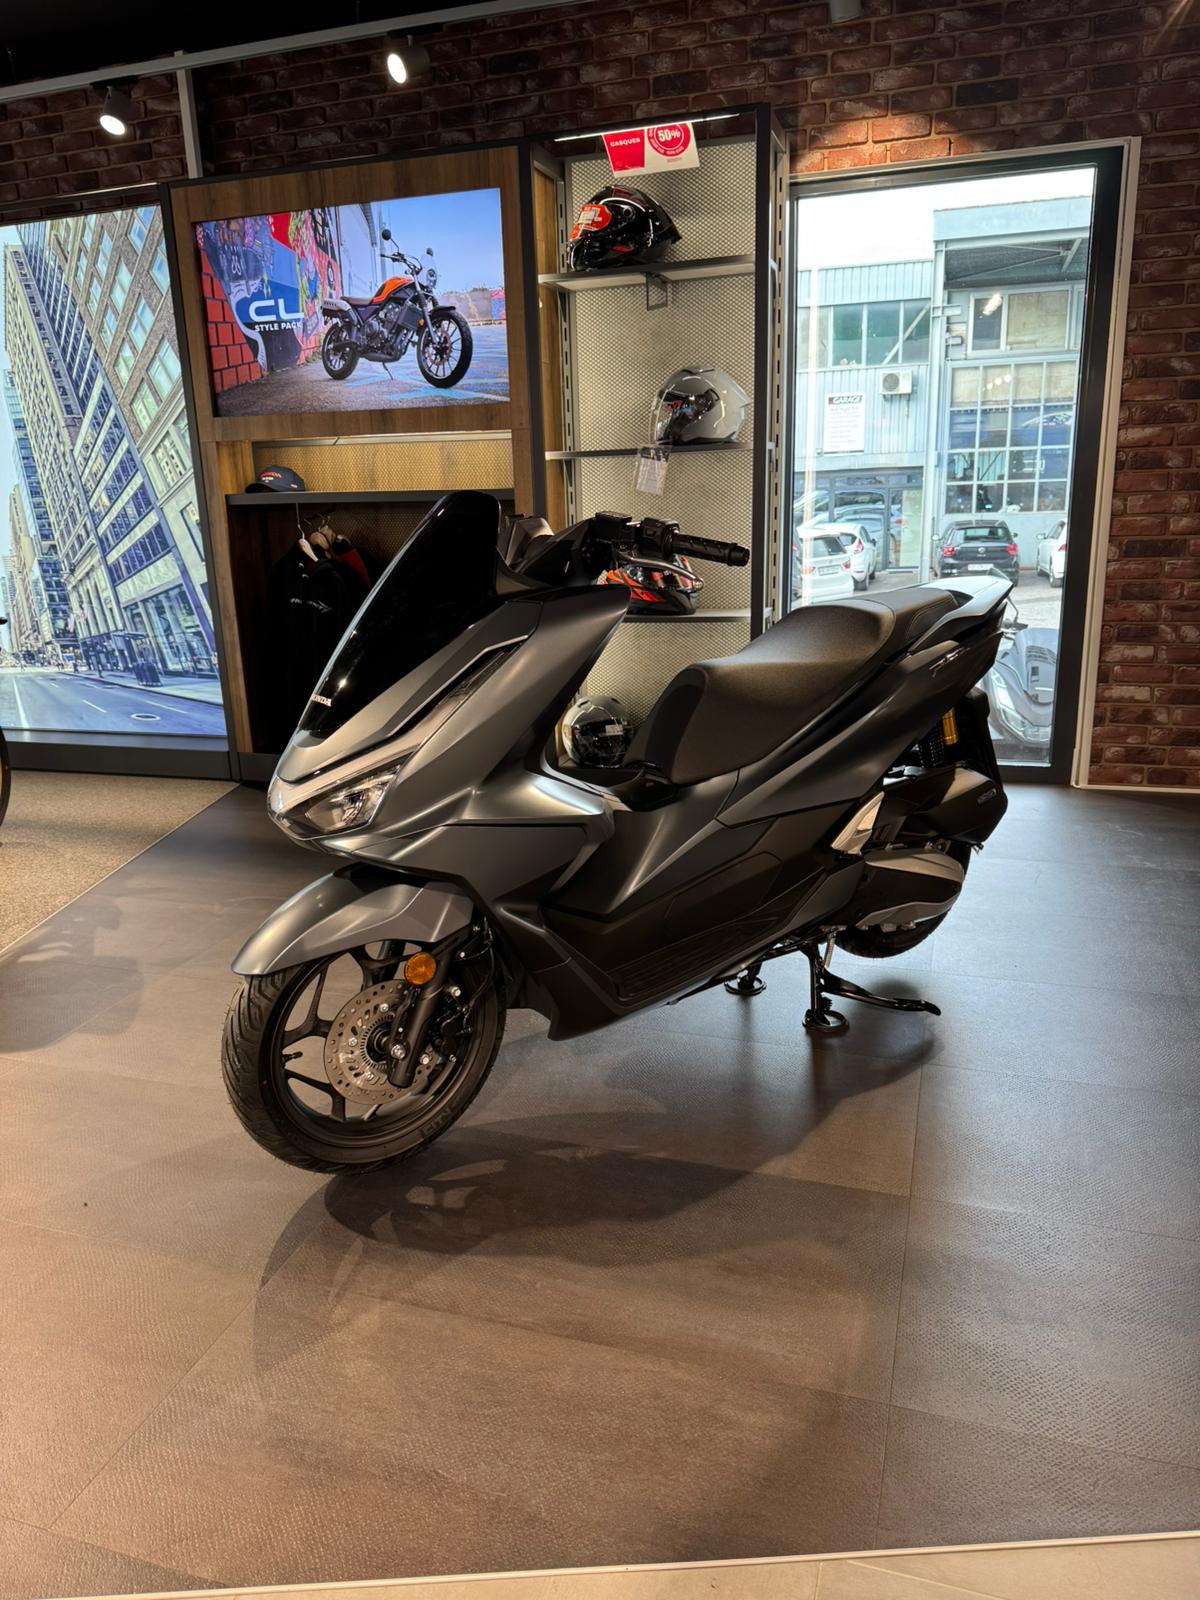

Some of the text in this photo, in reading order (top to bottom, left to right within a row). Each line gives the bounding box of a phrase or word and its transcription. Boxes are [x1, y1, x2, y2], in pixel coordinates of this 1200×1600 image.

[657, 128, 681, 142] 50%
[609, 137, 641, 148] CASQUES
[248, 297, 305, 323] CL
[254, 321, 303, 332] STYLE PACK
